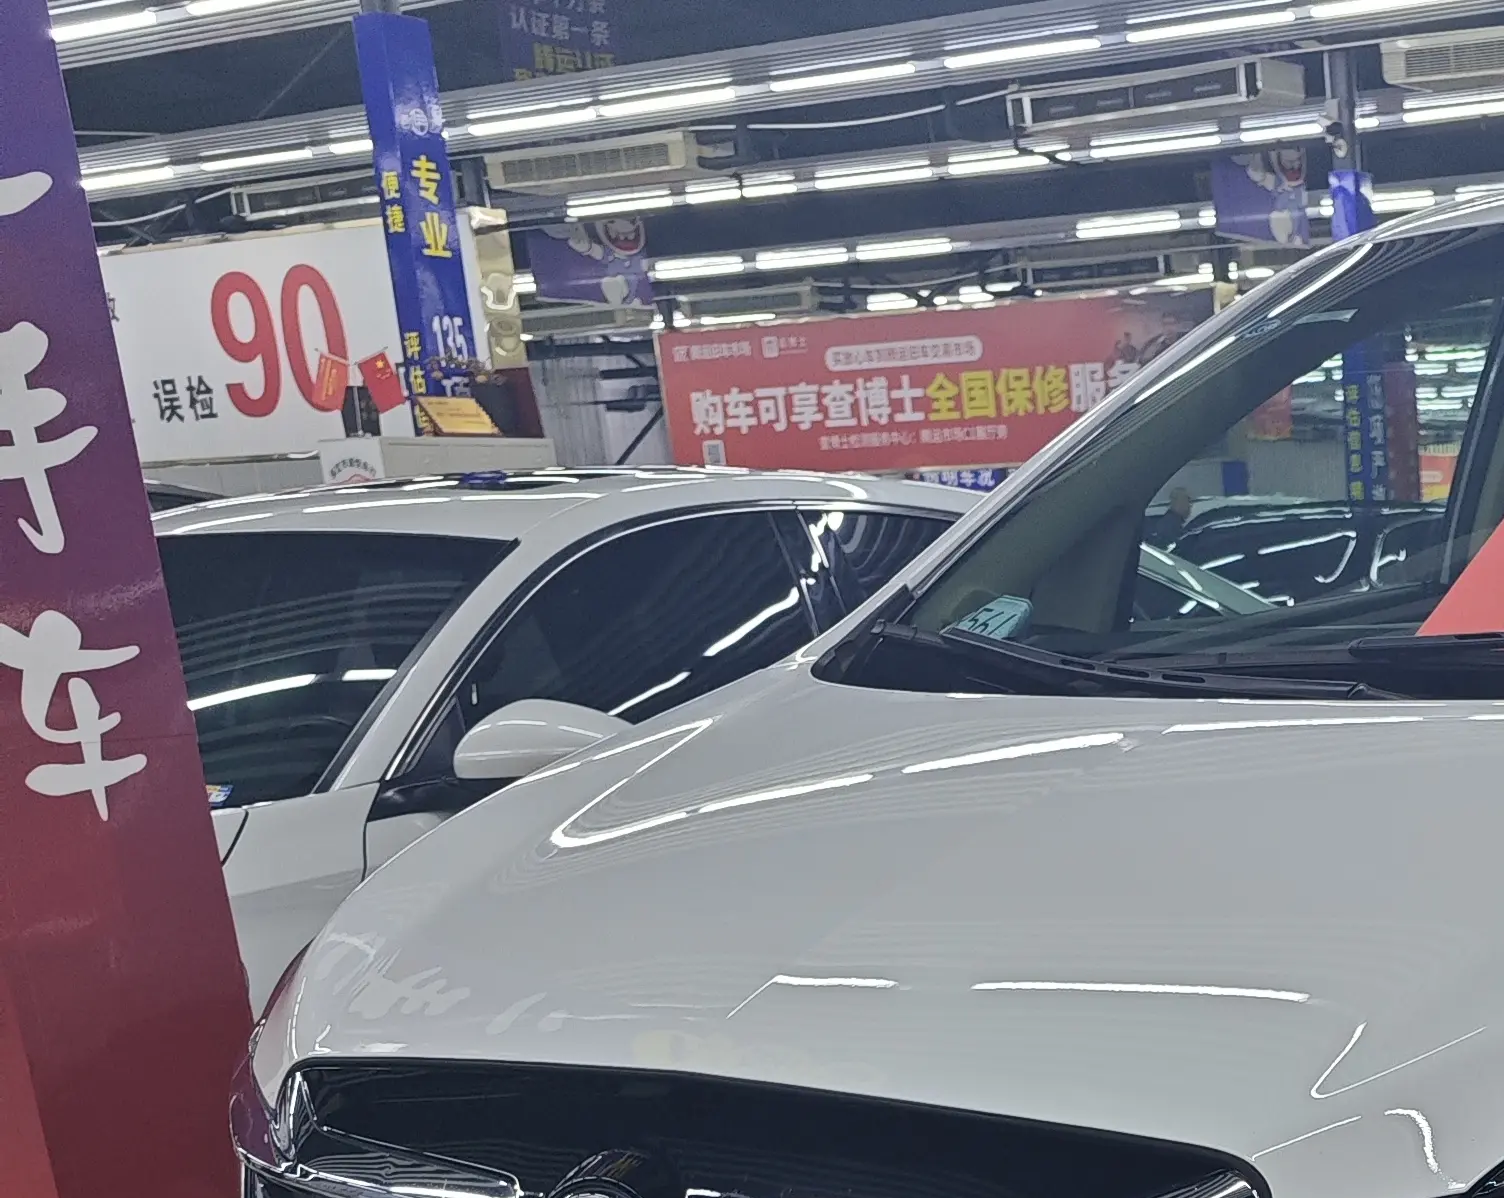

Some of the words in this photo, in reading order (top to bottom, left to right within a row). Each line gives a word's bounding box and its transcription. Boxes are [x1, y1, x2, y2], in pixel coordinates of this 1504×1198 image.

[381, 170, 406, 233] 便捷
[411, 155, 453, 258] 专业
[211, 264, 349, 418] 90
[152, 376, 218, 423] 误检
[0, 170, 147, 821] 手车
